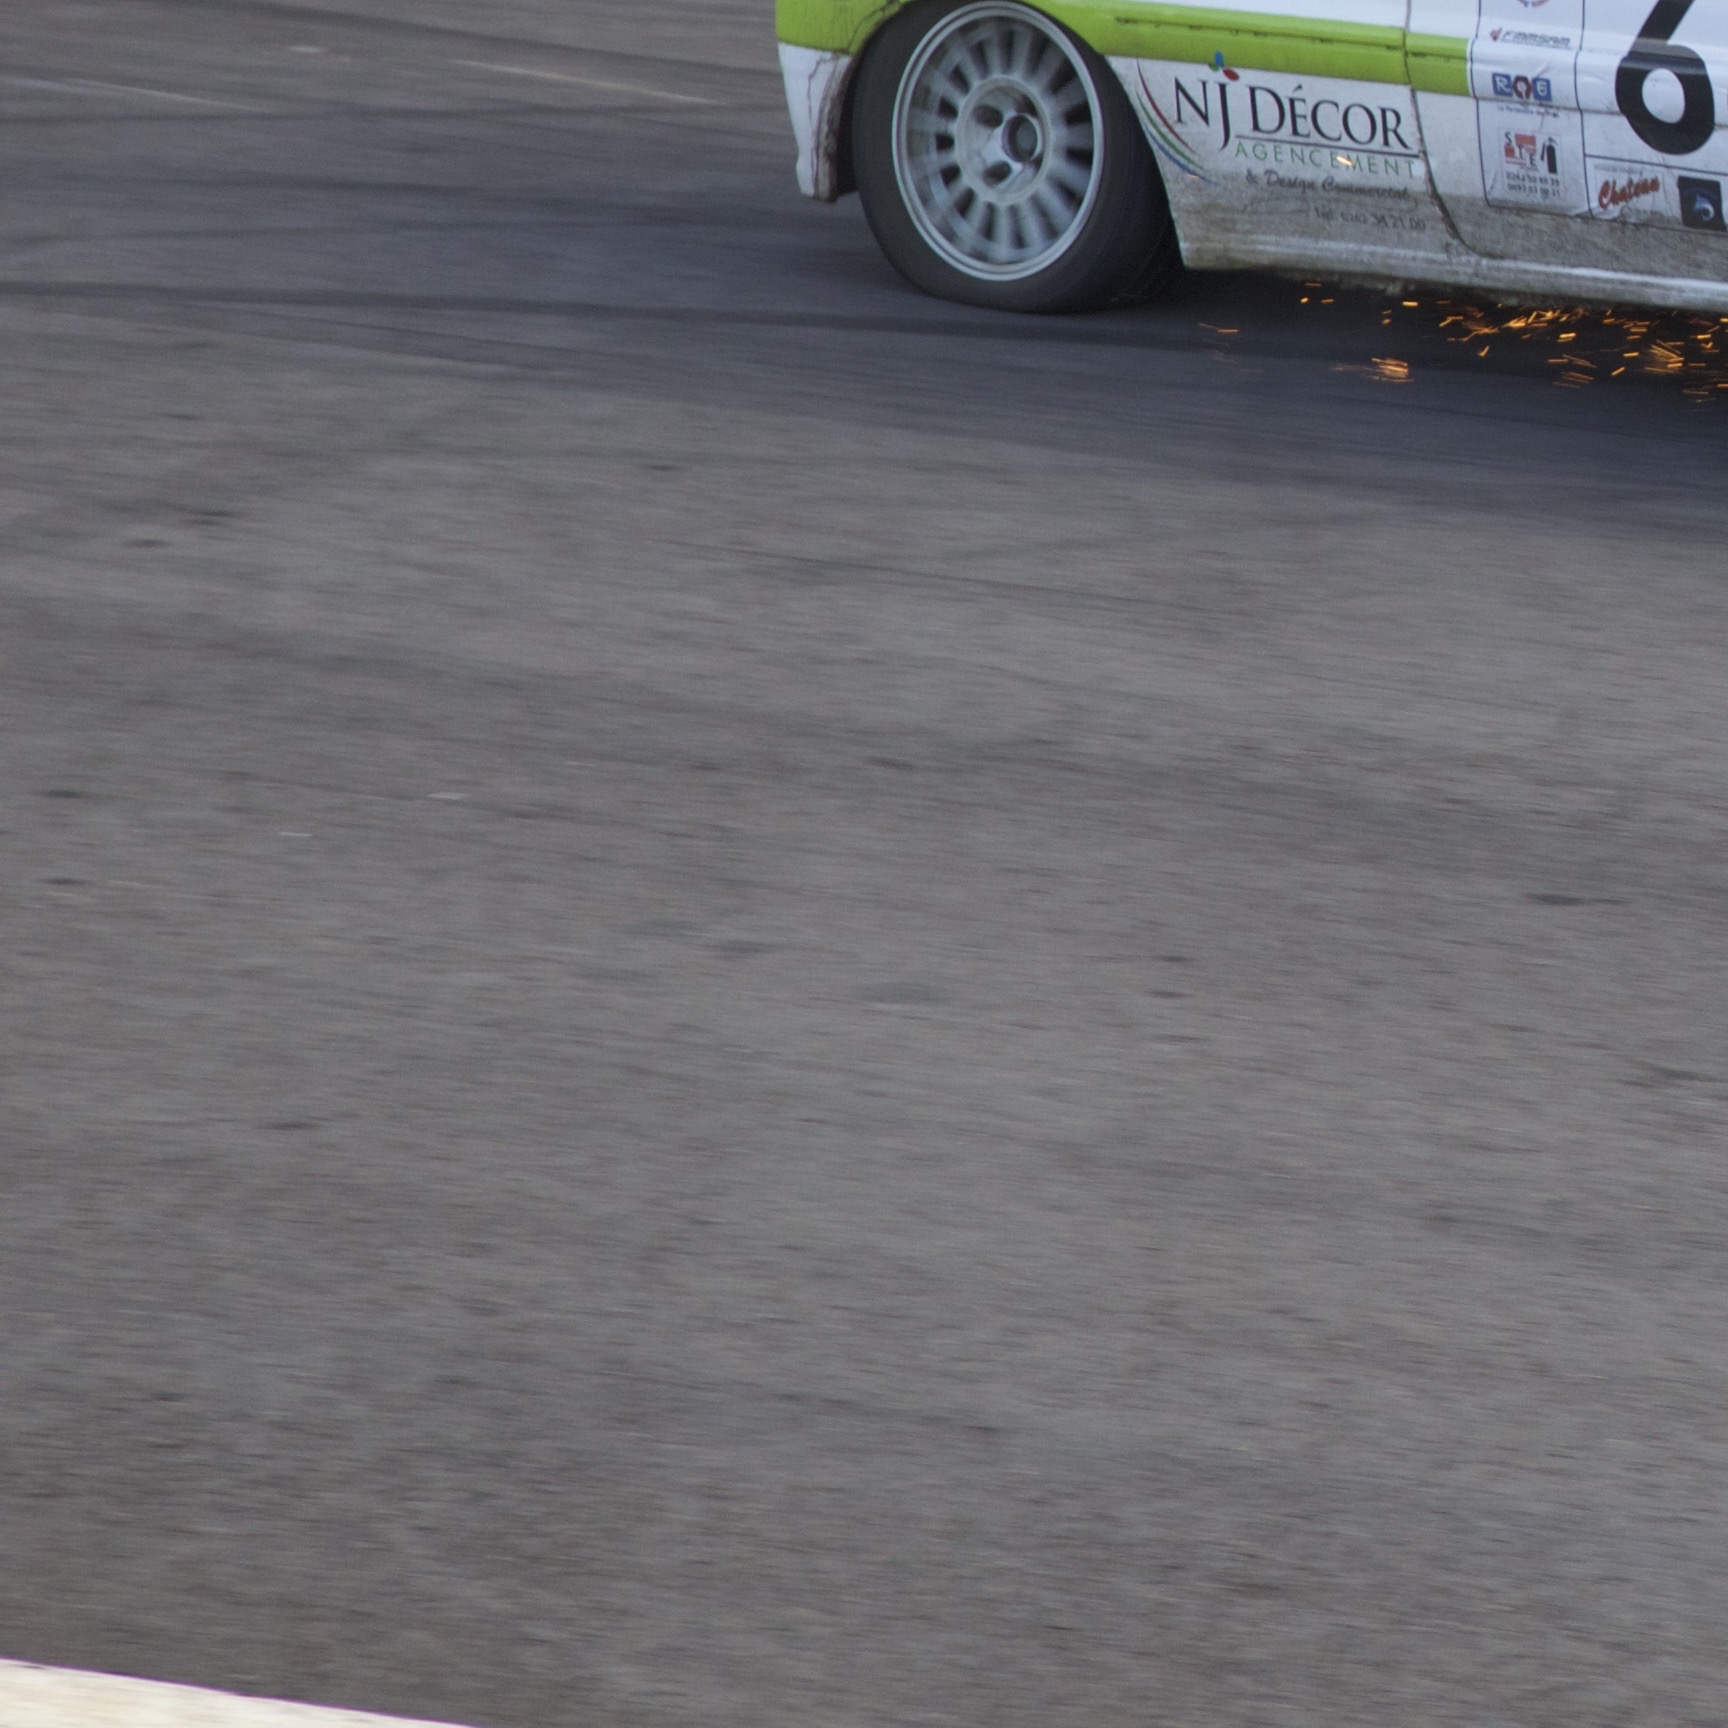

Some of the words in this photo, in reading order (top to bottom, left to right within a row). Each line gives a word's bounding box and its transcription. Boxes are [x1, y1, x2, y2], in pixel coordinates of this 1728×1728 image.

[1173, 75, 1232, 153] NJ
[1247, 83, 1413, 152] DÉCOR
[1234, 140, 1417, 179] AGENCEMENT
